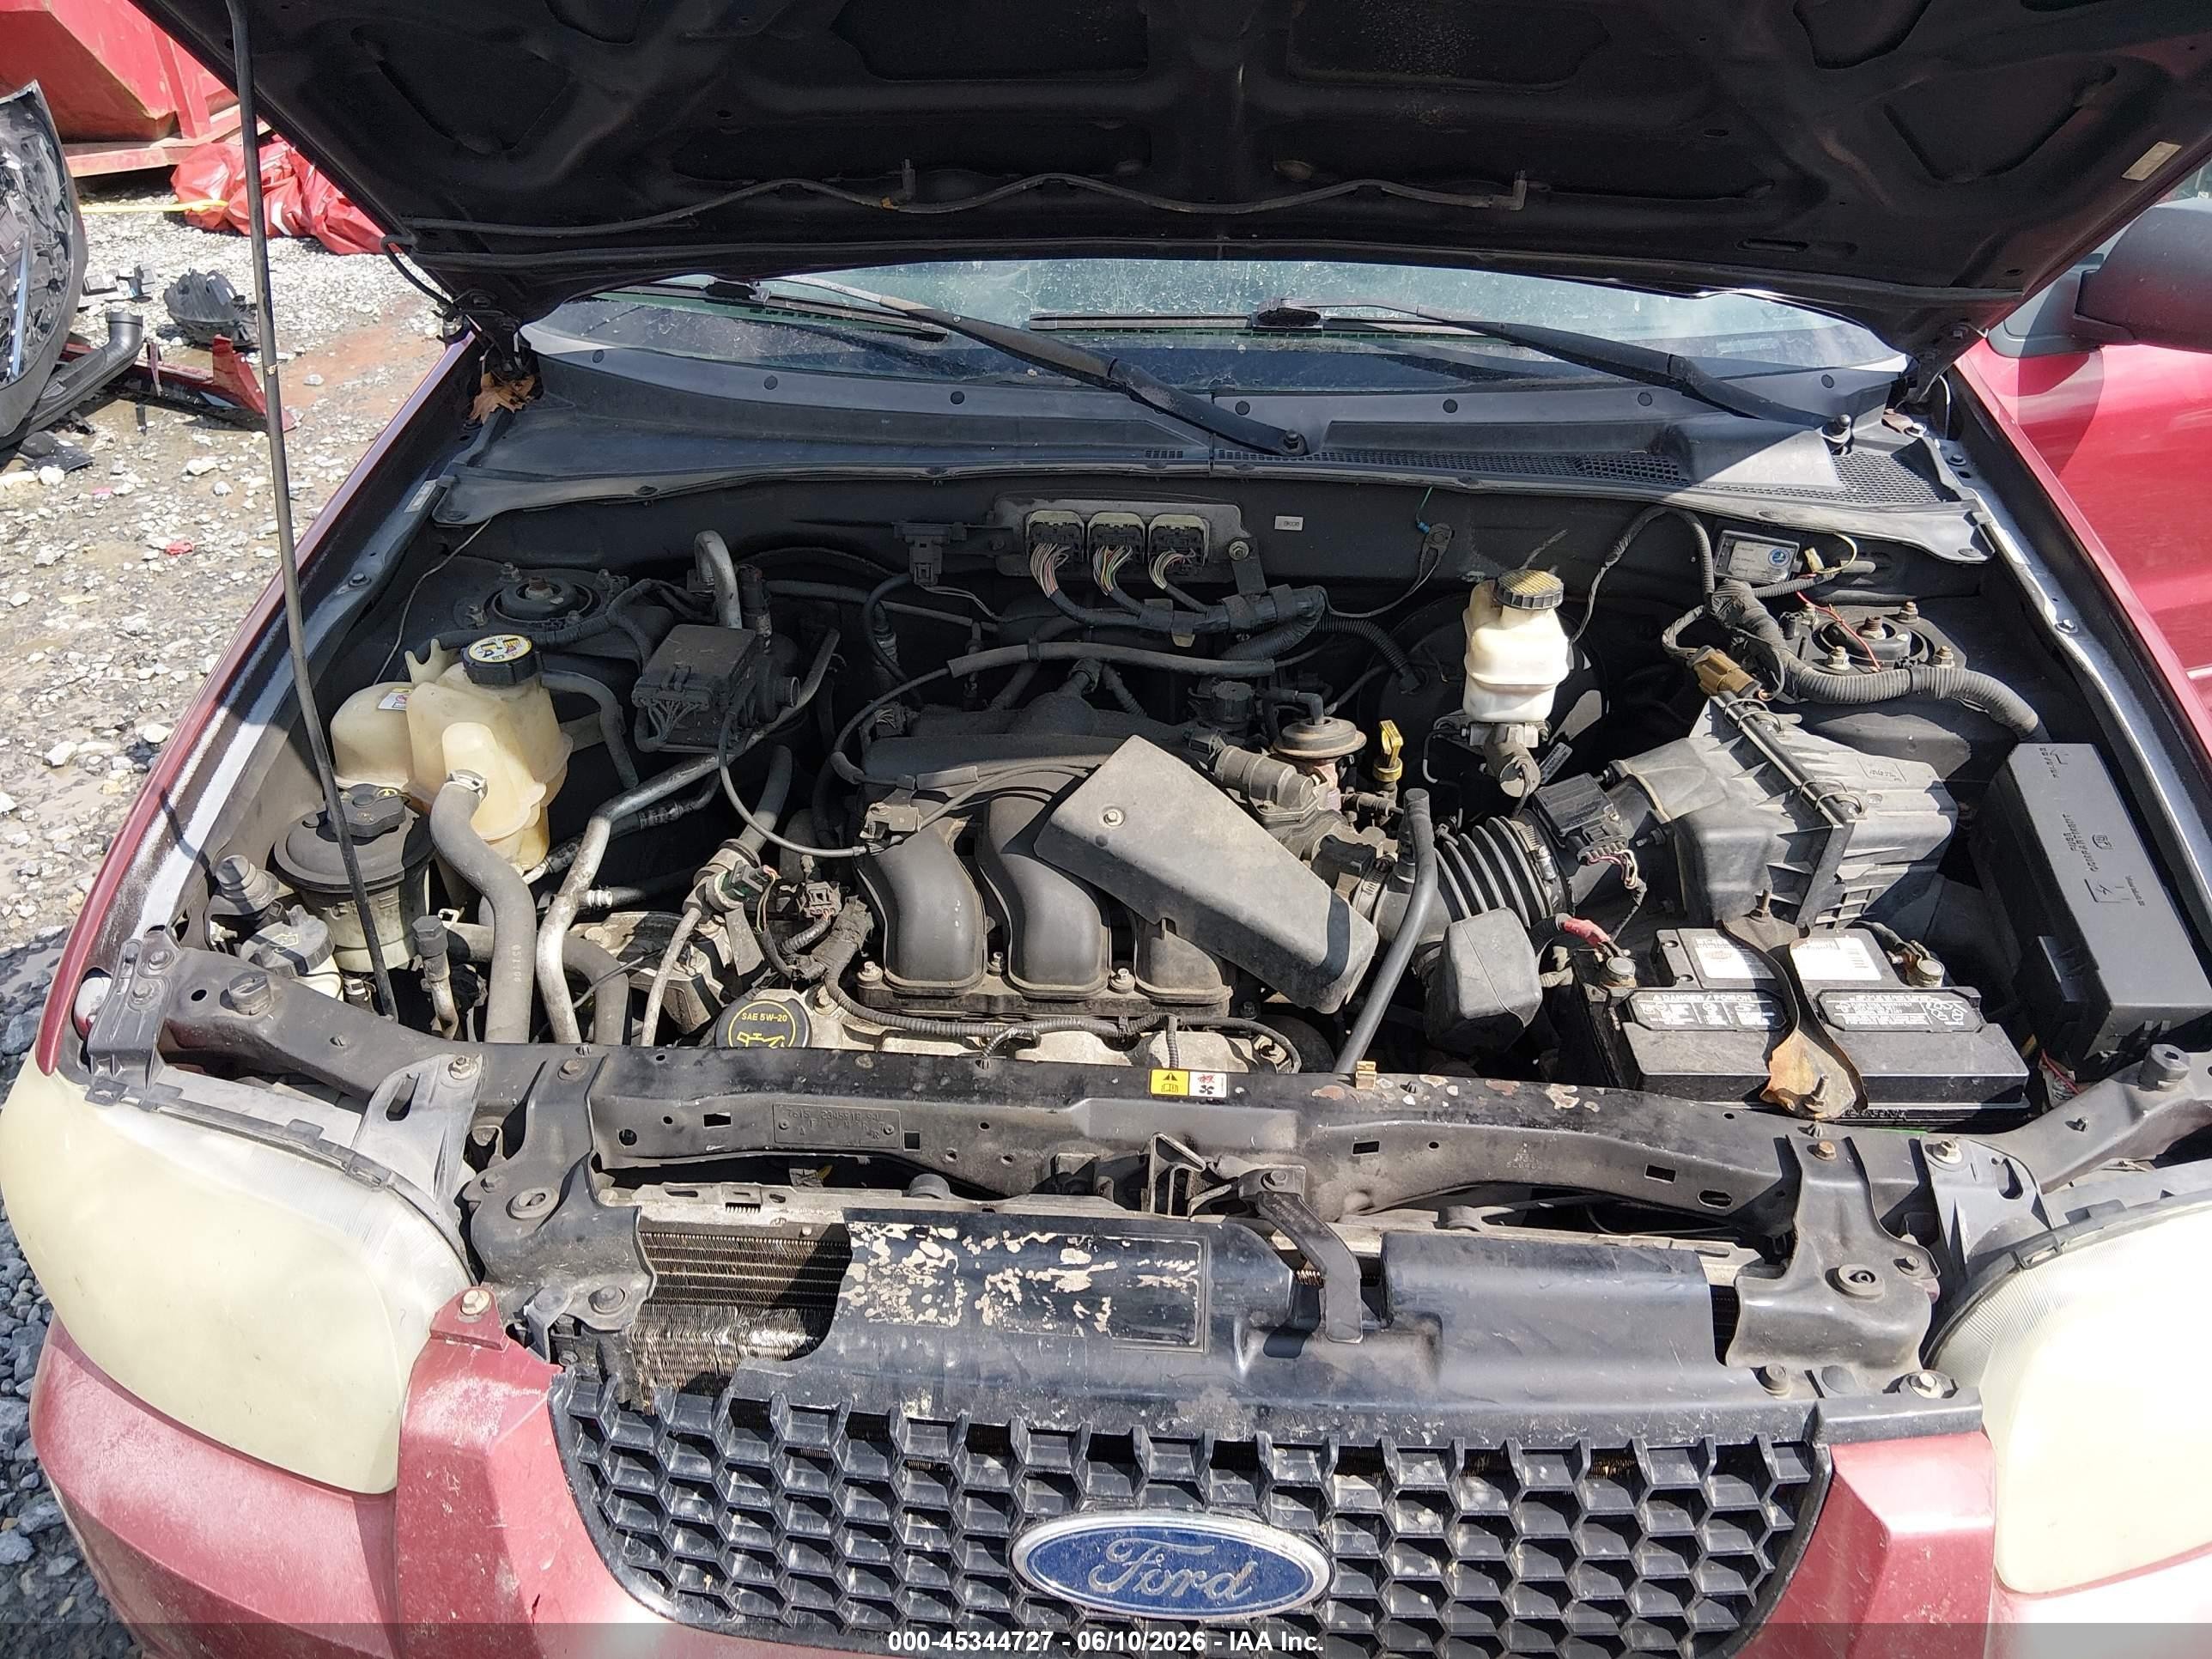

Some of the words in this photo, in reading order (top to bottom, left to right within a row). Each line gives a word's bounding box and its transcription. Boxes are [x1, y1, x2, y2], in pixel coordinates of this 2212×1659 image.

[741, 1012, 757, 1021] SAE
[760, 1013, 788, 1022] 5W-20
[1088, 1537, 1258, 1601] Ford
